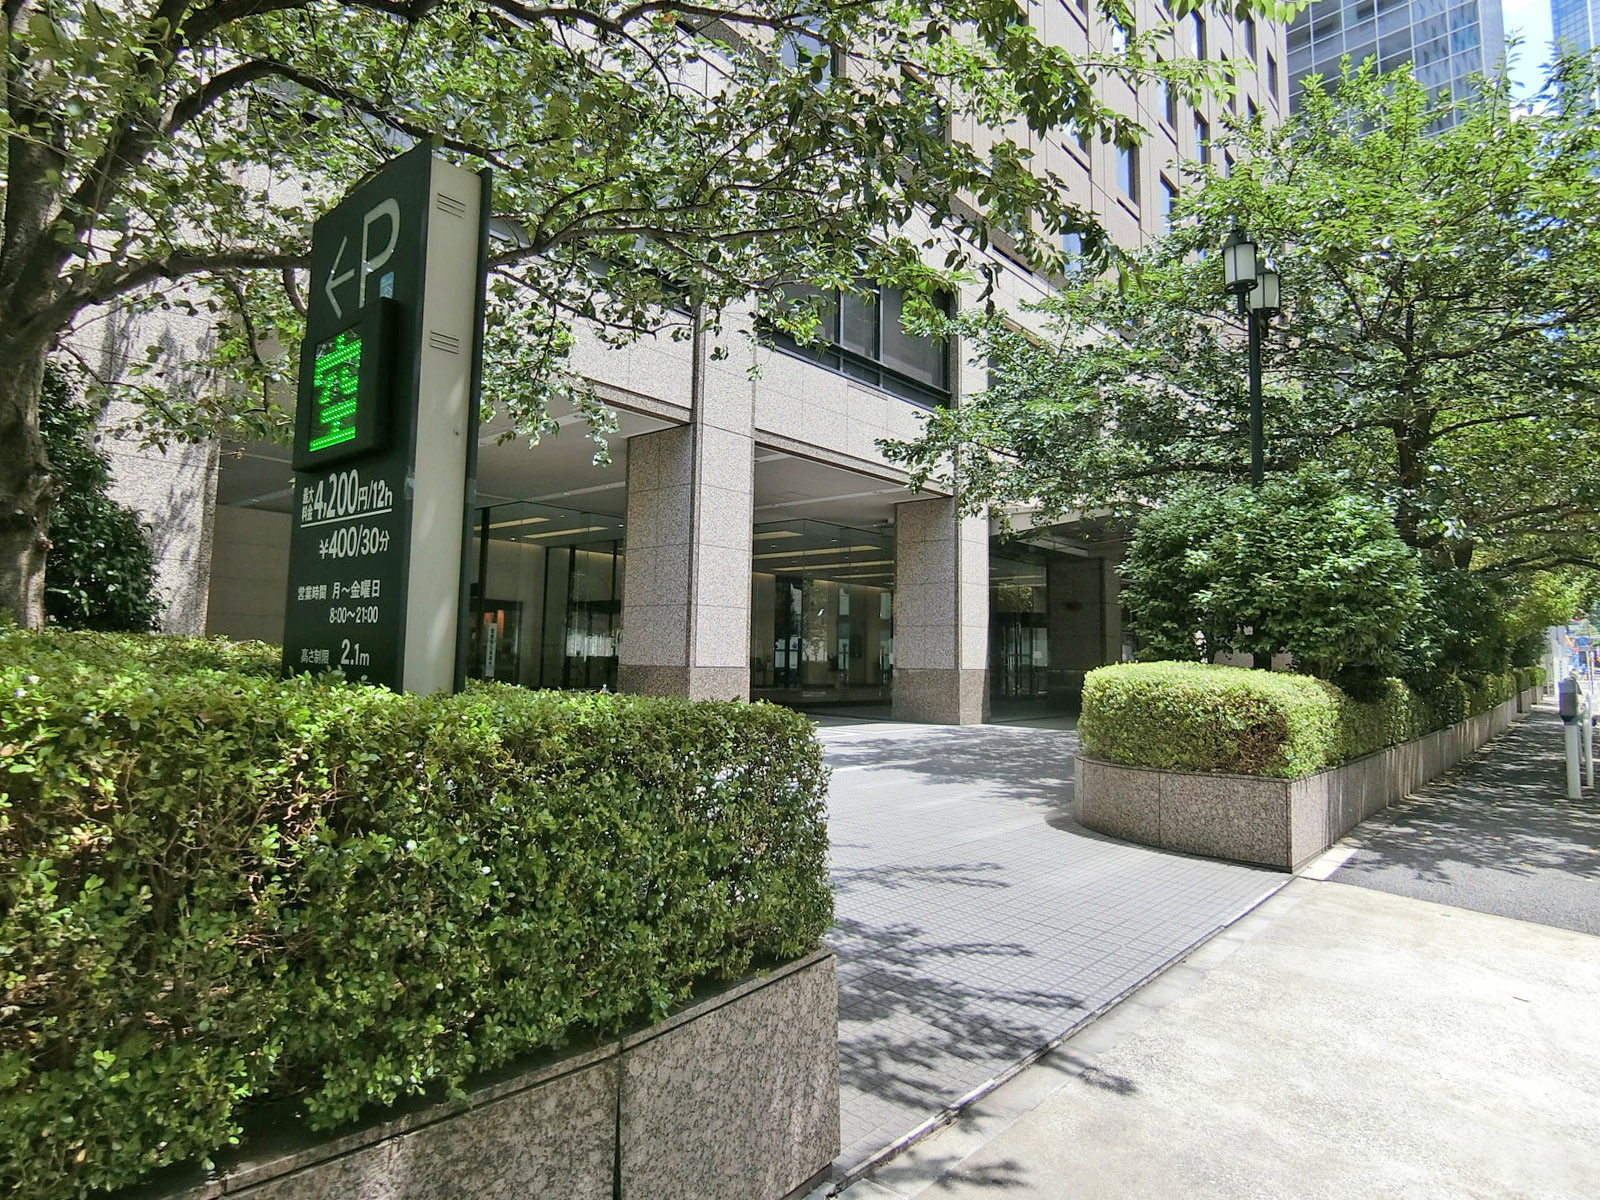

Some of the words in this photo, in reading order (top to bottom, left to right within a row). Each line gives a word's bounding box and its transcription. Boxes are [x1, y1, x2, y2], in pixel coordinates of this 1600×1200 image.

[359, 197, 400, 310] P
[309, 333, 362, 452] 空
[302, 486, 314, 504] 最大
[301, 504, 313, 522] 料金
[319, 524, 390, 559] ¥400/30分
[297, 584, 327, 601] 営業時間
[300, 648, 329, 664] 高さ制限
[340, 639, 370, 666] 2.1m
